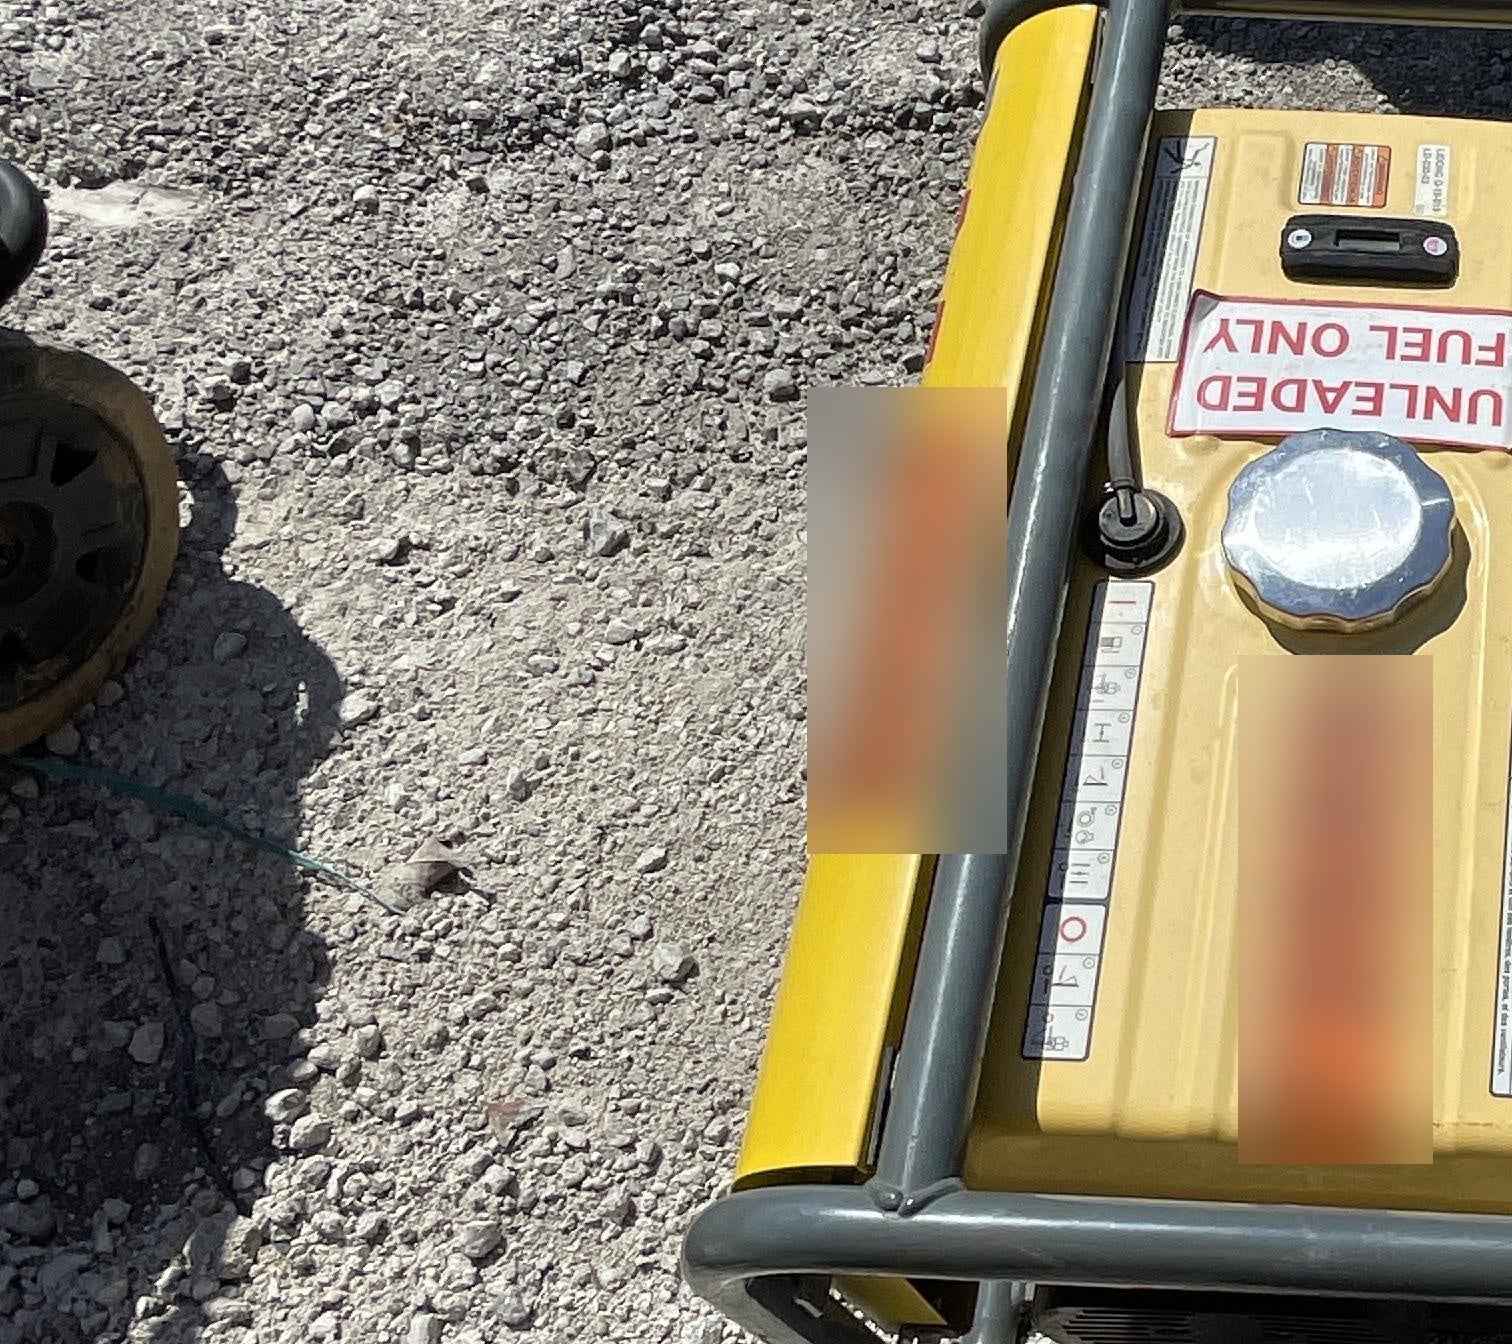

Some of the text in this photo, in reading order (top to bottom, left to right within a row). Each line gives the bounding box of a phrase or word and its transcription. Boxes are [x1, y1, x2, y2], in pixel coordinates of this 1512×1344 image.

[1203, 318, 1350, 358] ONLY
[1369, 324, 1506, 367] FUEL
[1196, 375, 1503, 428] UNLEADED
